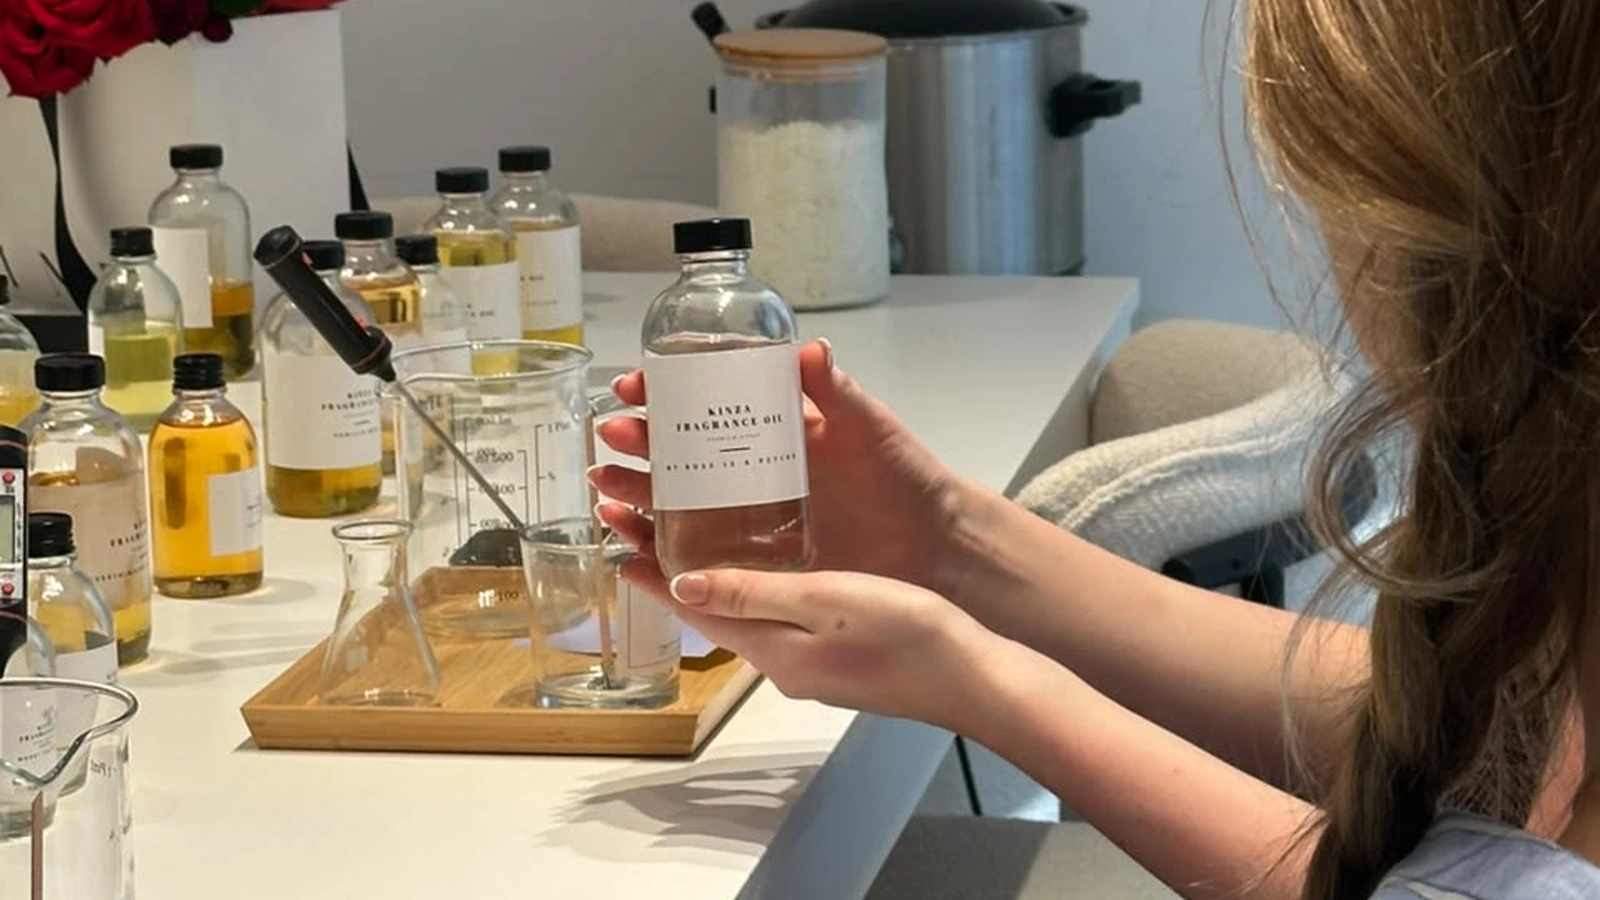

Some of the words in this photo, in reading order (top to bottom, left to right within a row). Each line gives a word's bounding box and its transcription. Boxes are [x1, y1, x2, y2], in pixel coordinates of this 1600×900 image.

[708, 404, 752, 416] KINZA
[676, 417, 758, 432] FRAGRANCE
[763, 414, 783, 425] OIL
